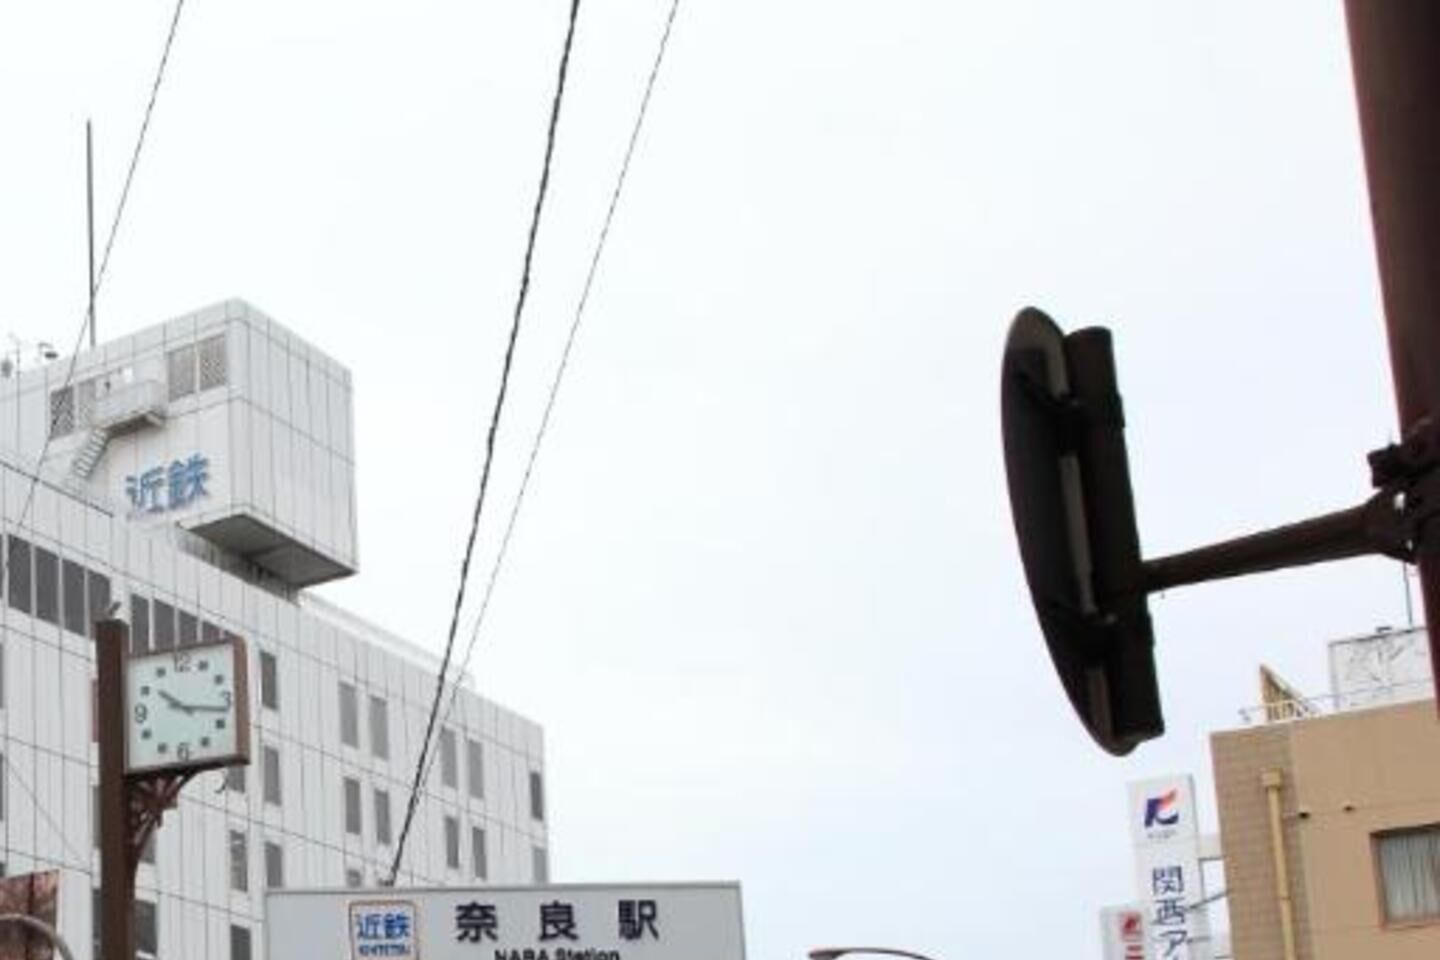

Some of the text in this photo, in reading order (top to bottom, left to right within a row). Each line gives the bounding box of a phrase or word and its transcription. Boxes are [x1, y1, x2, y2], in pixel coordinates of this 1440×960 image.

[126, 453, 209, 511] 近鉄
[355, 911, 410, 940] 近鉄
[456, 901, 659, 941] 奈良駅
